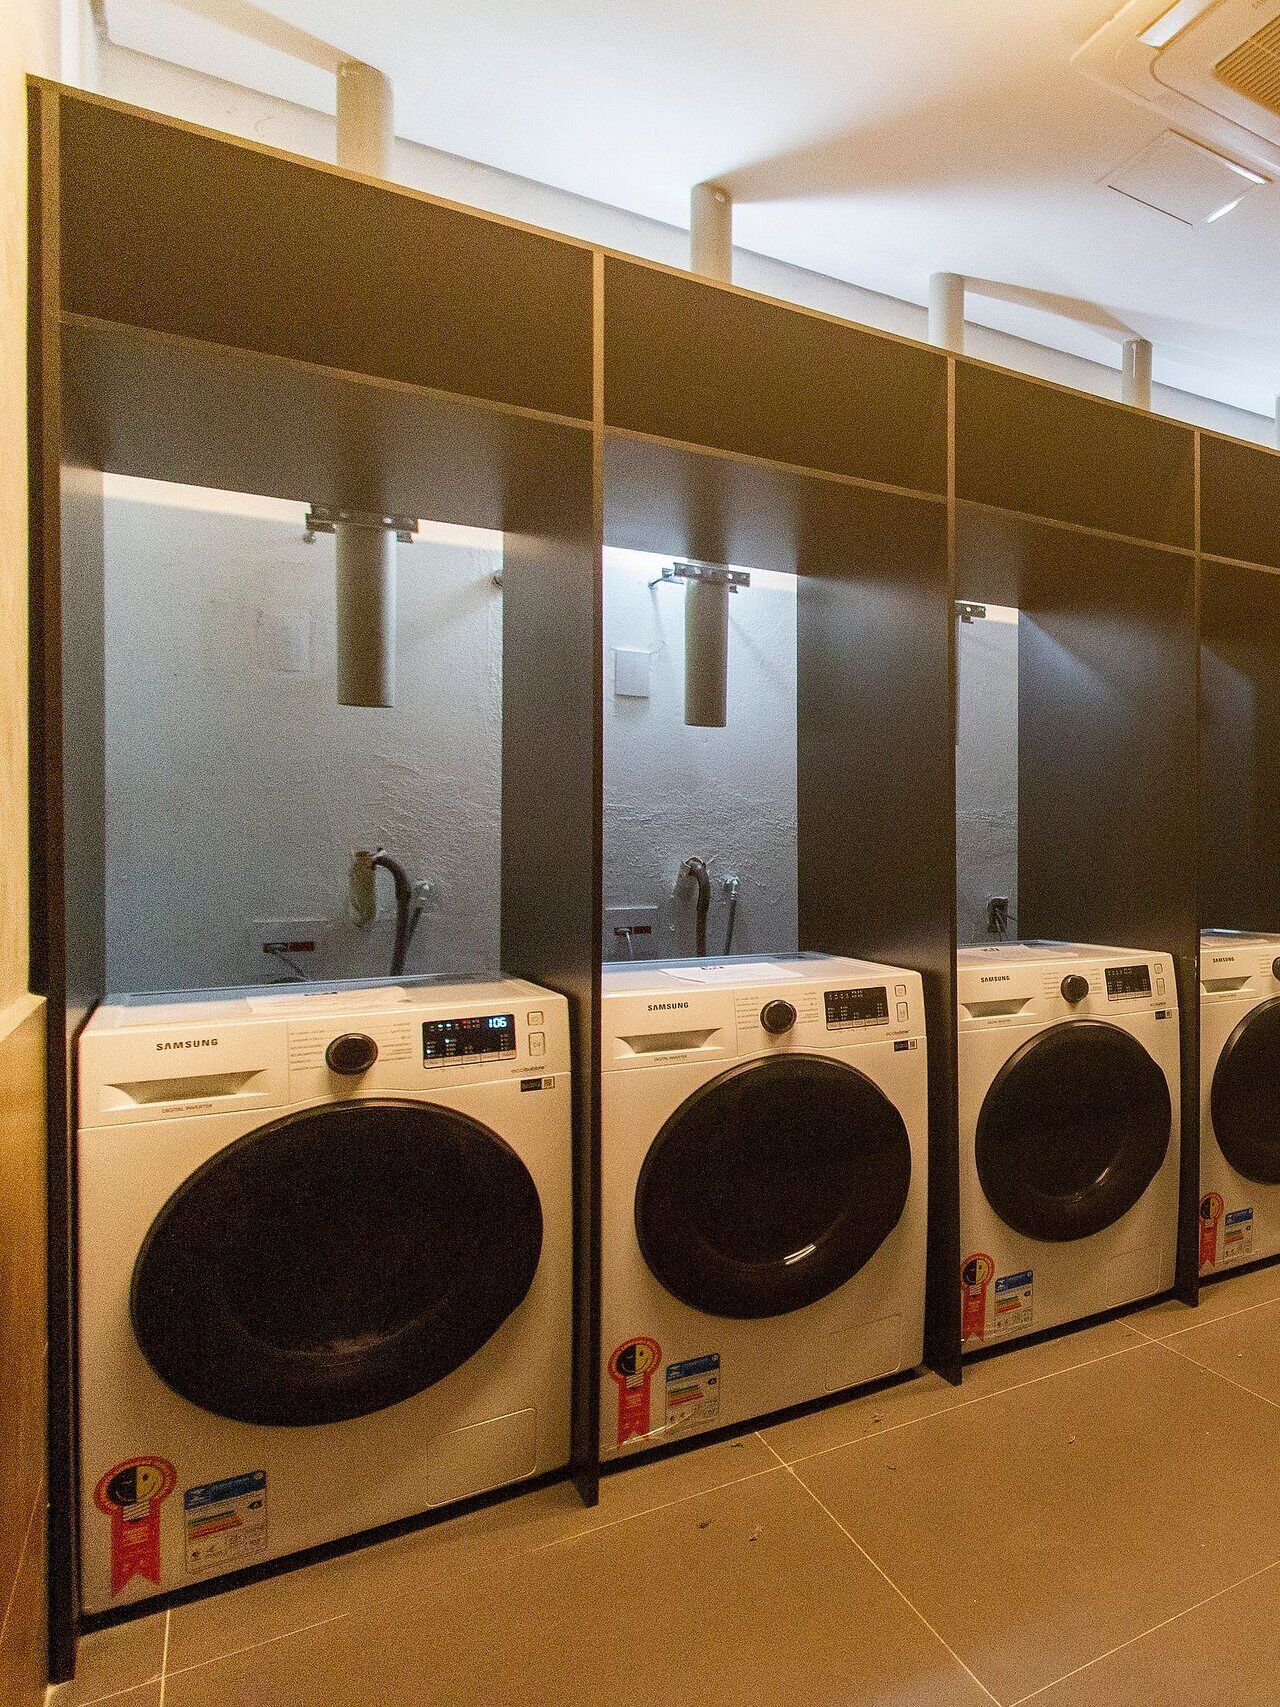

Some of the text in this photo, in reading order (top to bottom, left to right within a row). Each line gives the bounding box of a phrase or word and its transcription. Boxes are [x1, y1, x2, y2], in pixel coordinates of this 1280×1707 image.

[980, 975, 1011, 983] SAMSUNG
[647, 1001, 689, 1012] SAMSUNG
[156, 1038, 218, 1051] SAMSUNG
